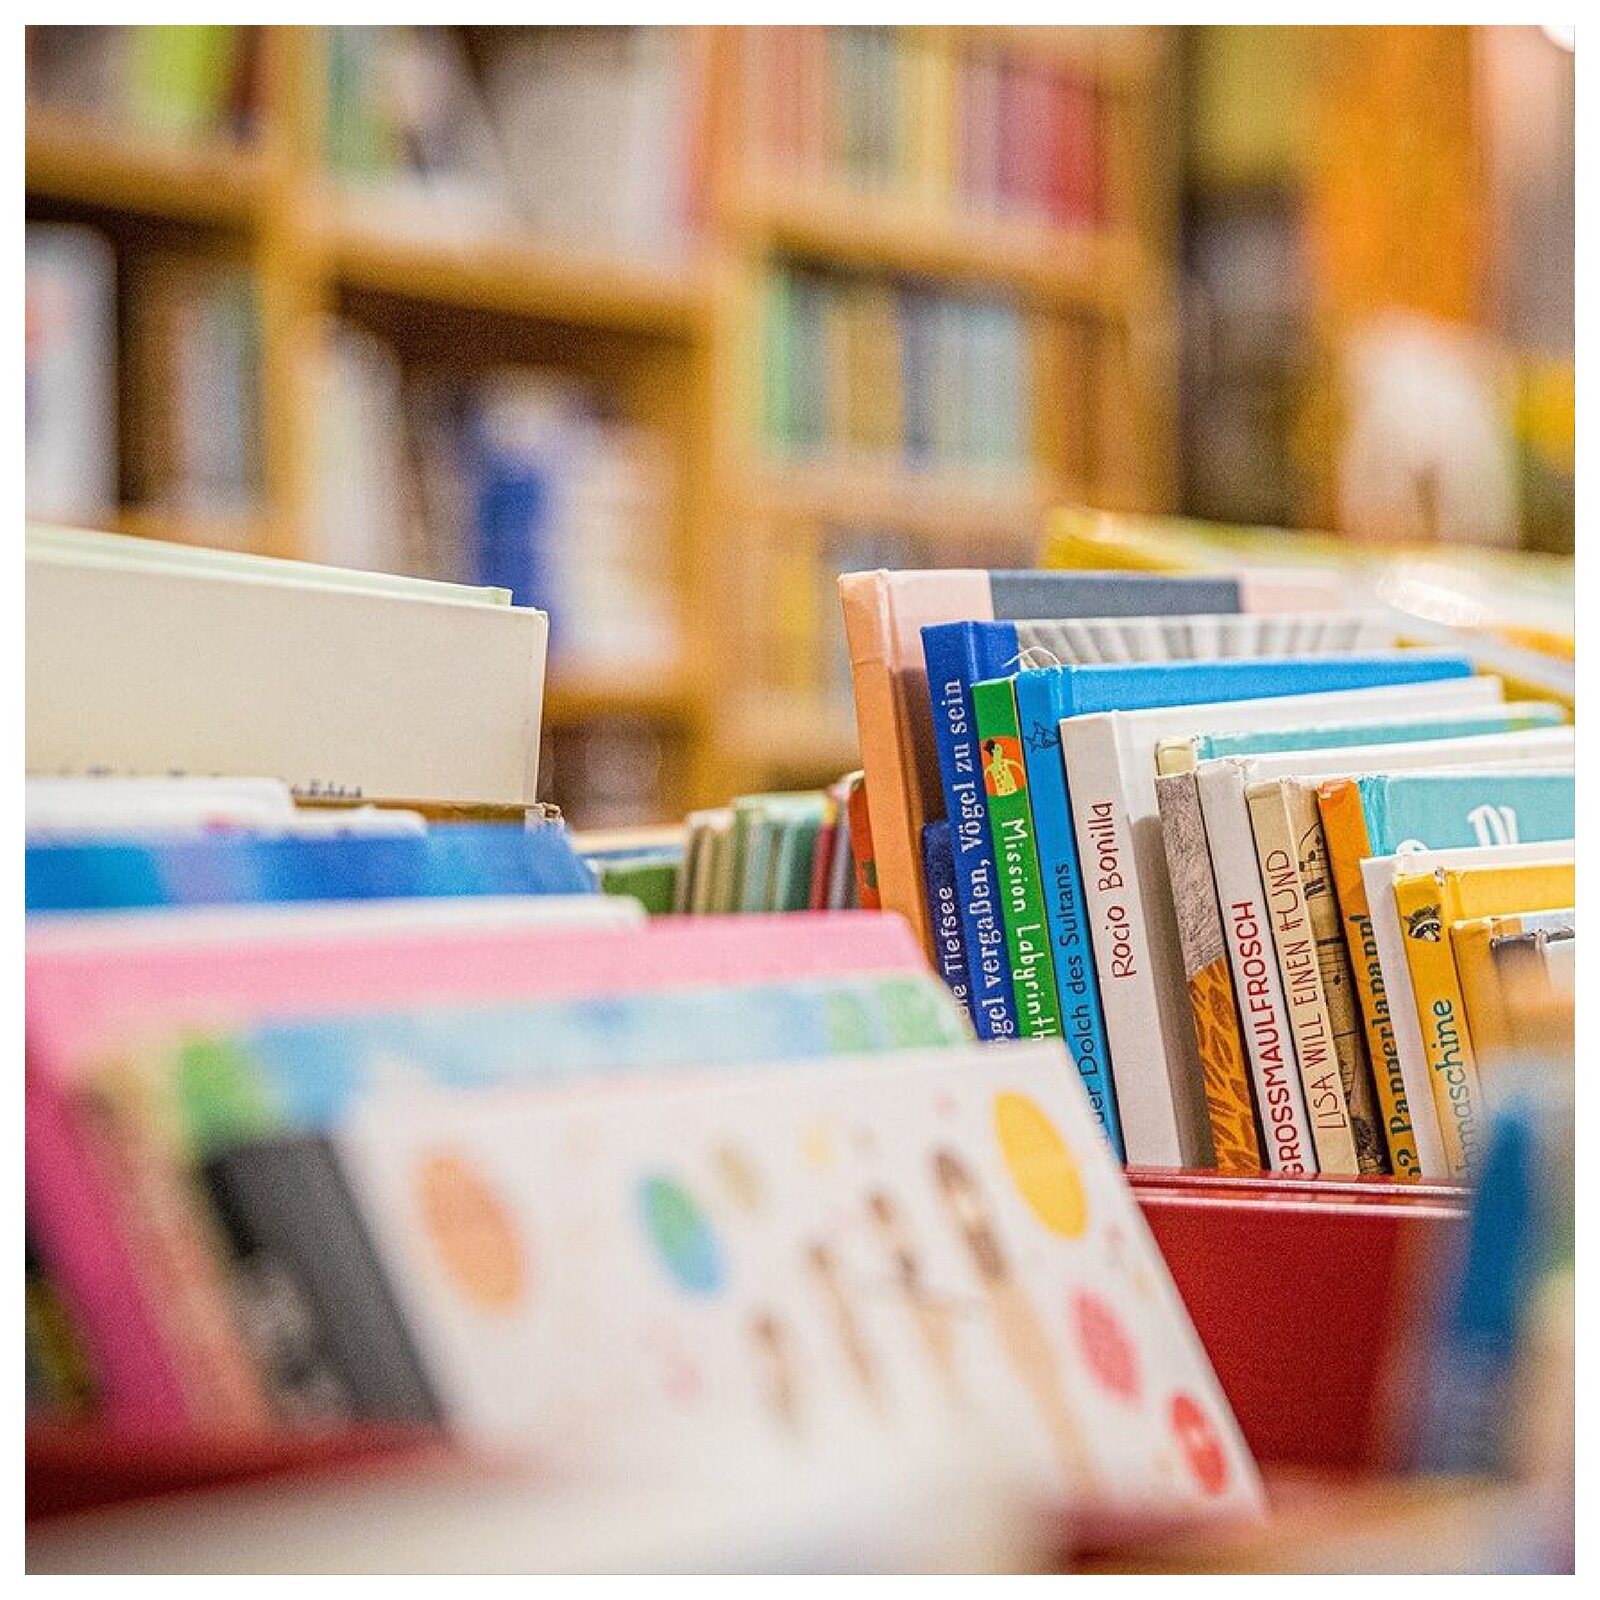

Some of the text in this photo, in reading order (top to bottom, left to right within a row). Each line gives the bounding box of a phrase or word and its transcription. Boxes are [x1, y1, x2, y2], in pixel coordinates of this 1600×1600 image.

[942, 680, 968, 734] sein
[955, 742, 973, 773] zu
[952, 781, 985, 853] Vögel
[1088, 802, 1123, 891] Bonilla
[938, 886, 963, 975] Tiefsee
[969, 858, 1002, 988] vergaßen,
[1001, 818, 1057, 1042] Mission Labyrinth
[1058, 863, 1080, 947] Sultans
[1066, 954, 1086, 994] des
[1267, 850, 1347, 1129] LISA WILL EINEN HUND
[1071, 1003, 1098, 1076] Dolch
[1231, 902, 1304, 1173] GROSSMAULFROSCH
